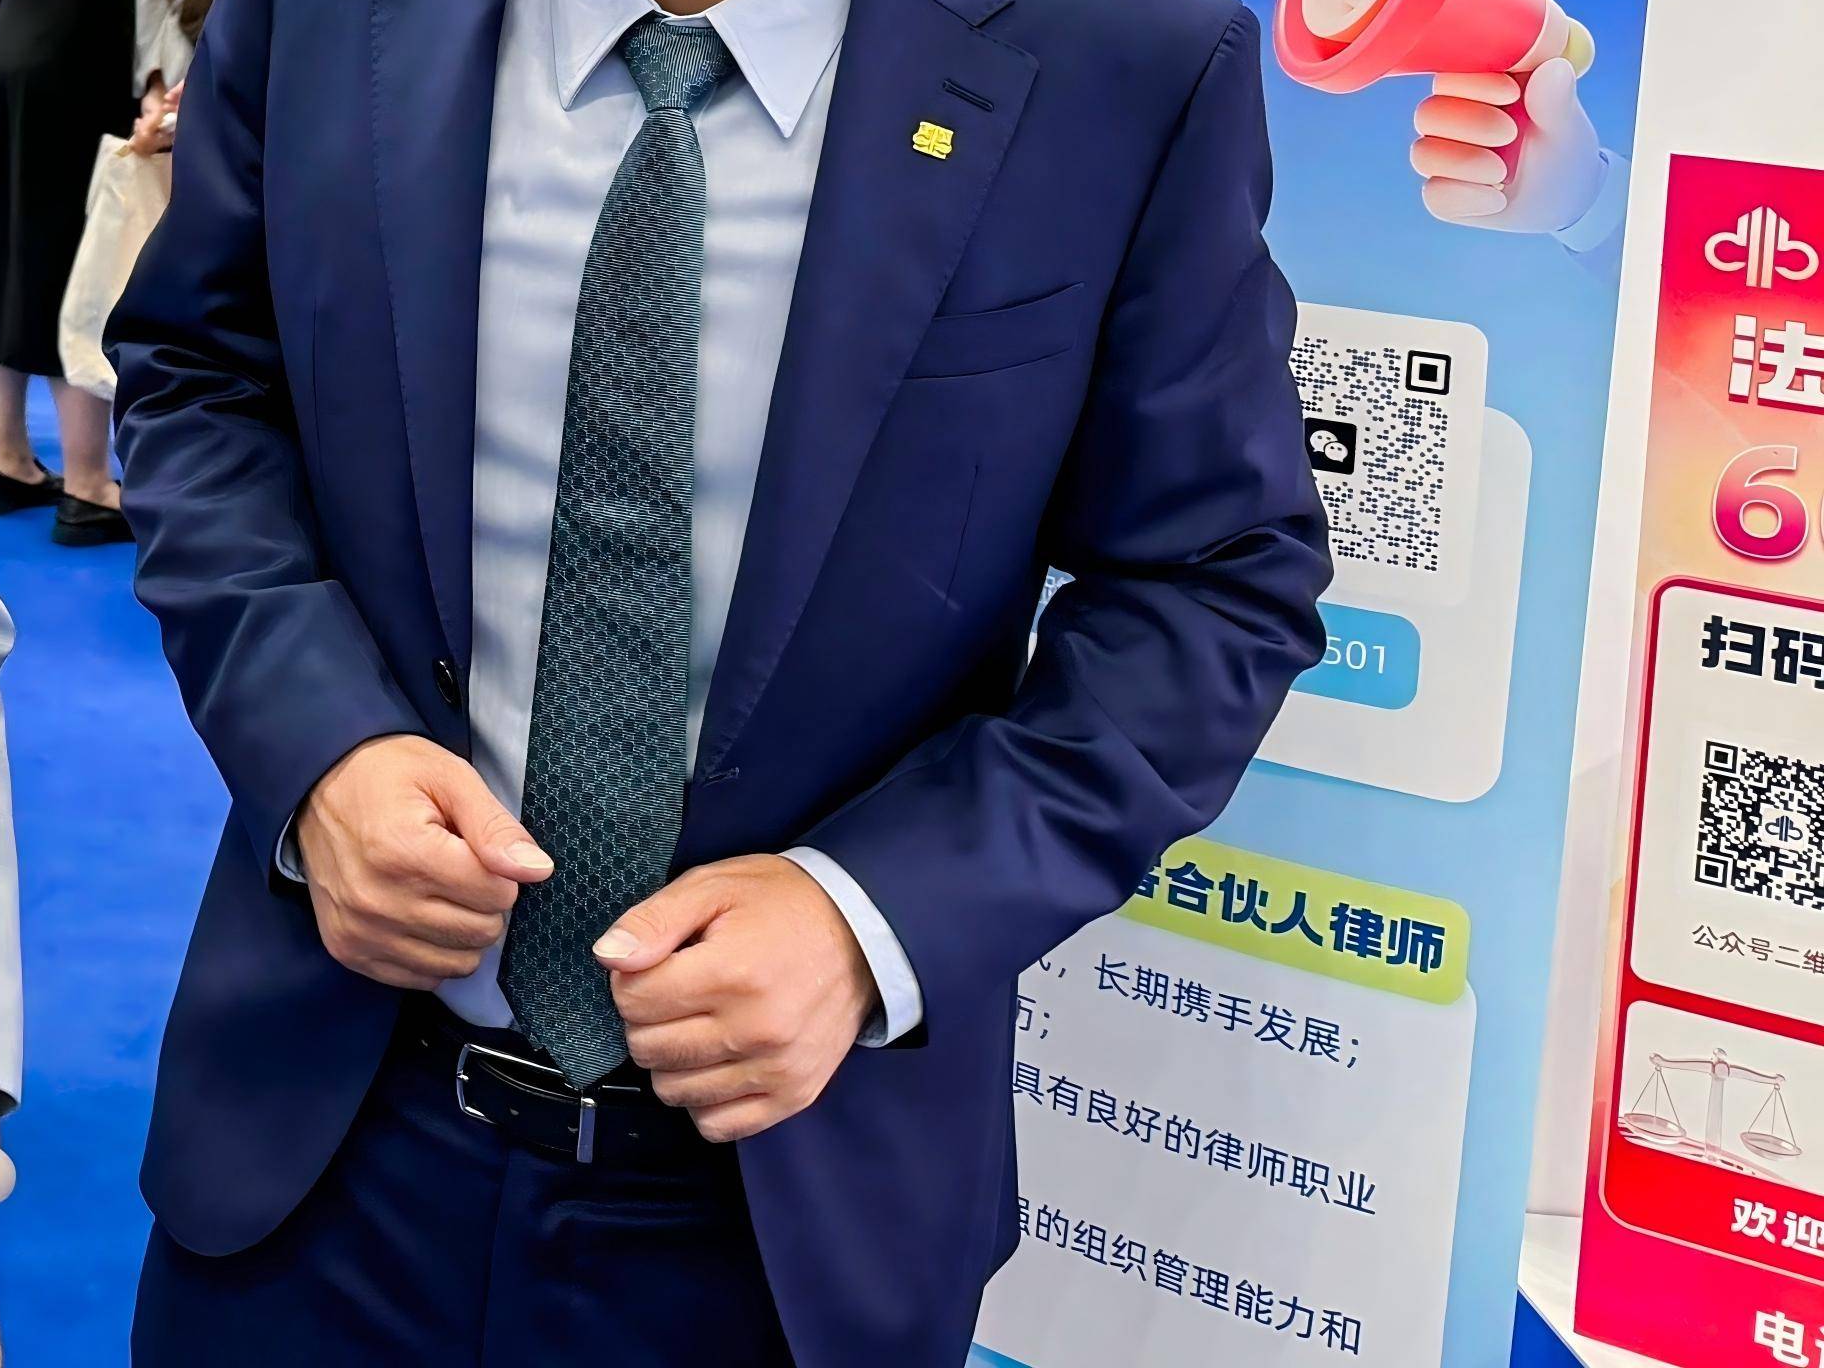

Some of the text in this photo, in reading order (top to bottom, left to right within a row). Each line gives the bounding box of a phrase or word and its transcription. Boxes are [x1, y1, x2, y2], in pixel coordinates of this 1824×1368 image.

[1713, 444, 1824, 562] 6
[1323, 635, 1386, 674] 501
[1701, 614, 1824, 690] 扫码
[1691, 923, 1824, 975] 公众号二维
[1033, 952, 1361, 1070] ，长期携手发展；
[1012, 1060, 1377, 1216] 具有良好的律师职业
[1730, 1196, 1824, 1256] 欢迎
[1753, 1310, 1824, 1368] 电
